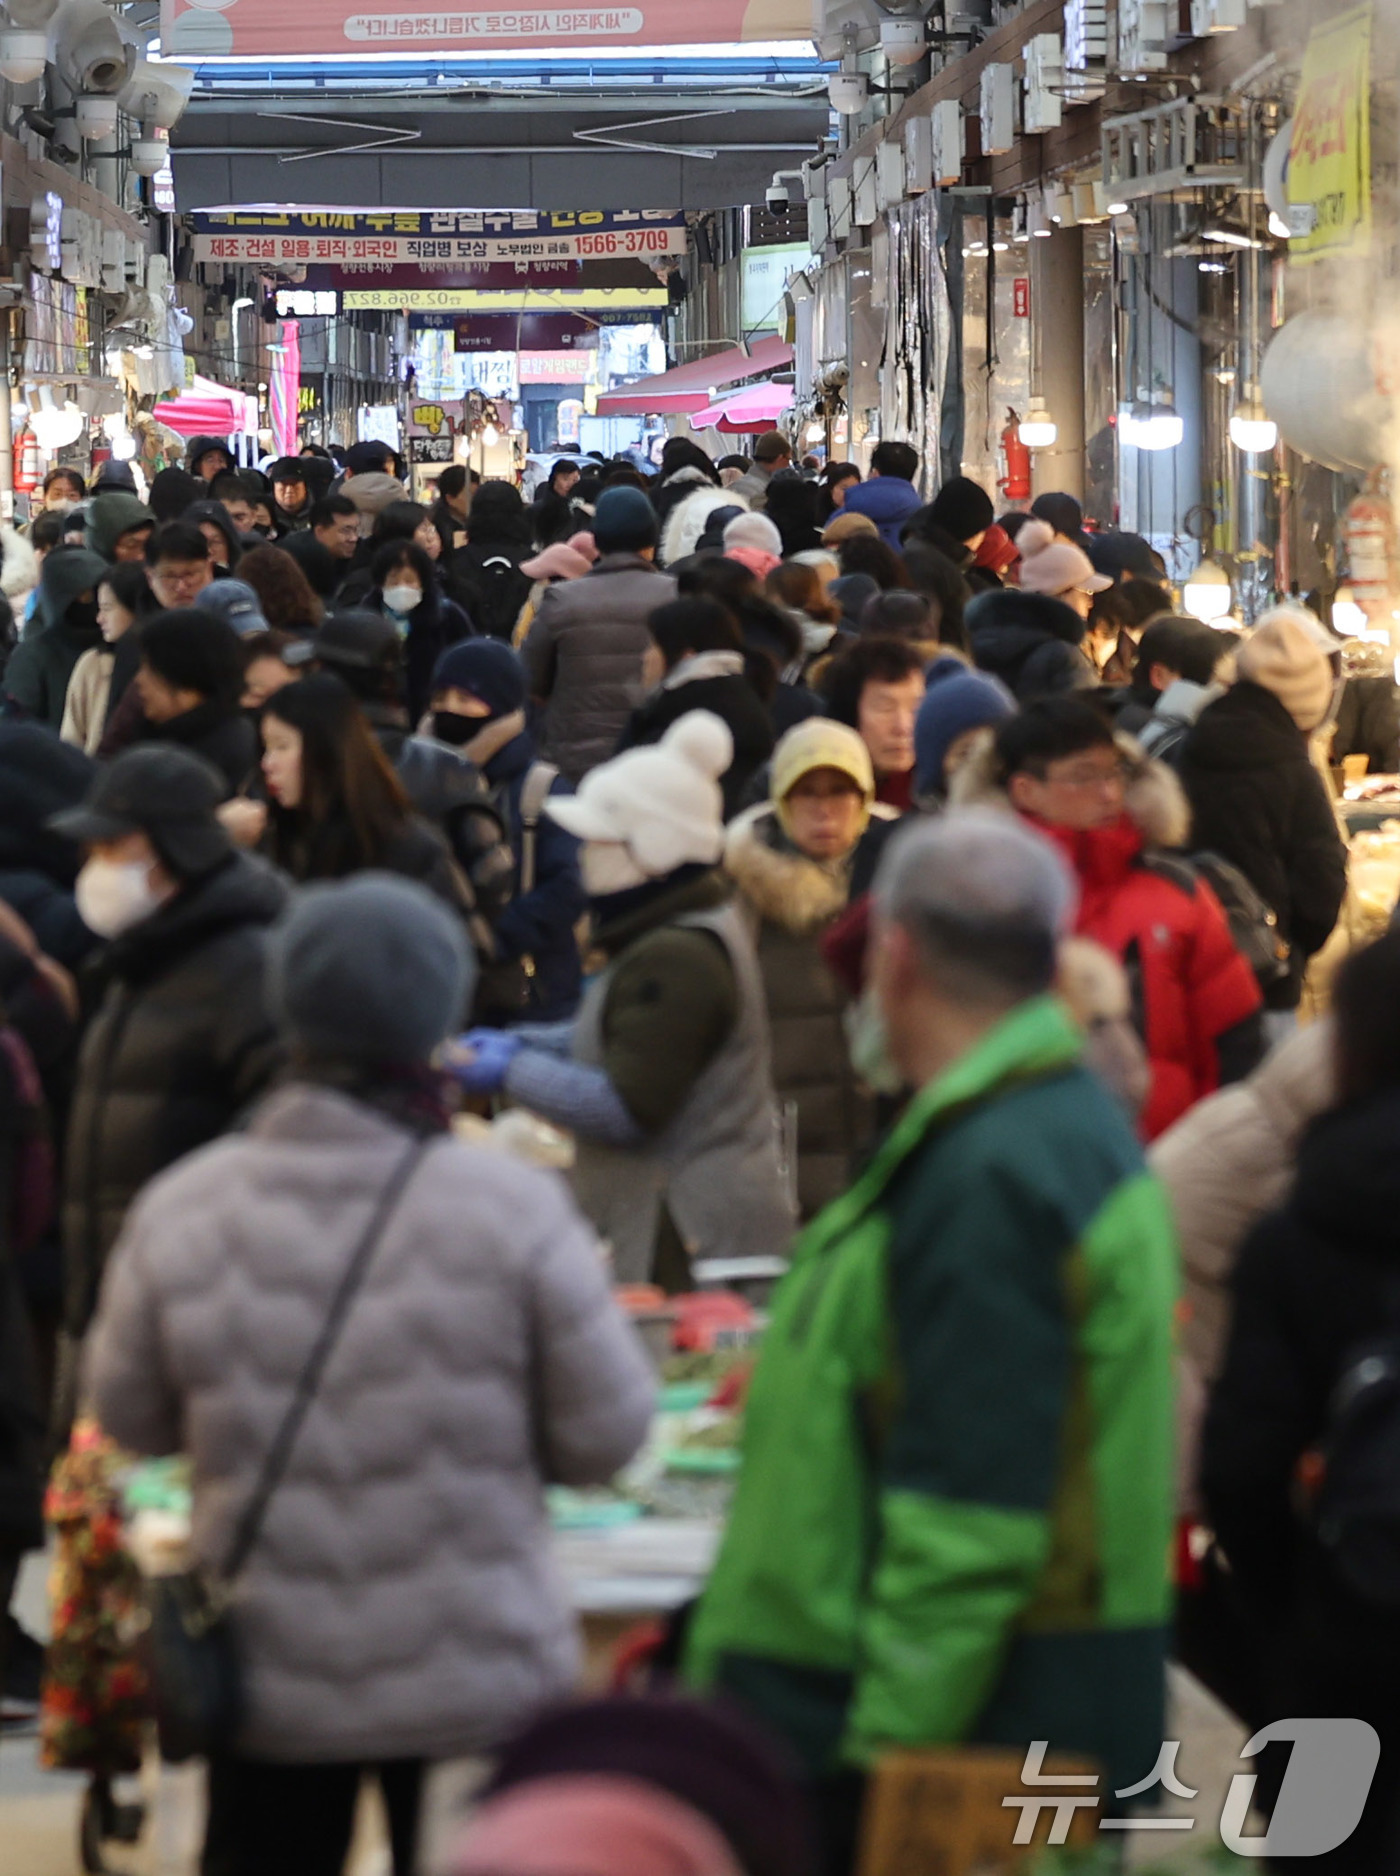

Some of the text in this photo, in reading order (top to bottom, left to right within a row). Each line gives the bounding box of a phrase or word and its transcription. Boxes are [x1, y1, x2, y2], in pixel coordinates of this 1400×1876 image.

[210, 239, 276, 258] 제조·건설
[407, 240, 451, 258] 직업병
[457, 240, 487, 257] 보상
[497, 243, 543, 256] 노무법인
[574, 230, 668, 255] 1566-3709
